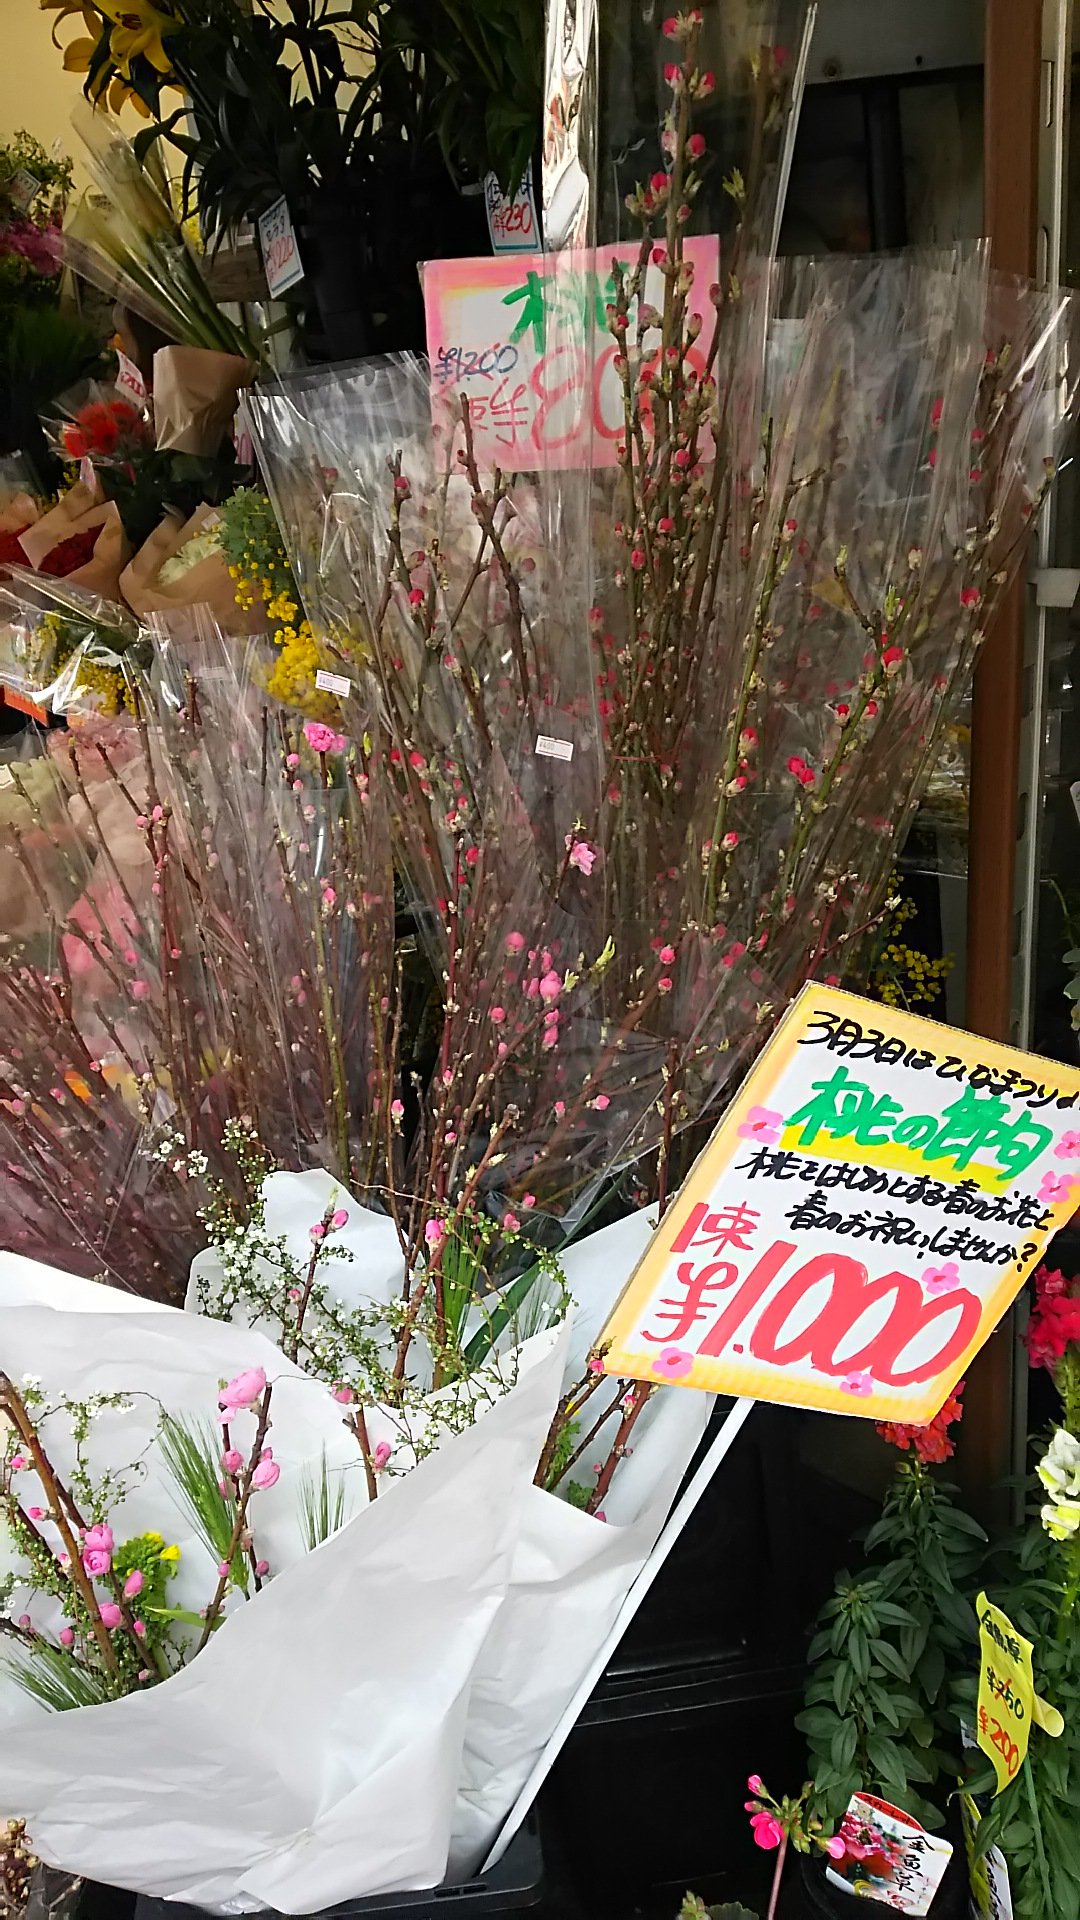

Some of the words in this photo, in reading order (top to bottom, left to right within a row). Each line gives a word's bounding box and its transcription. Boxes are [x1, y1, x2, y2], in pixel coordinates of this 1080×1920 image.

[783, 1065, 1054, 1181] 桃の節句
[979, 1704, 1020, 1777] ¥200
